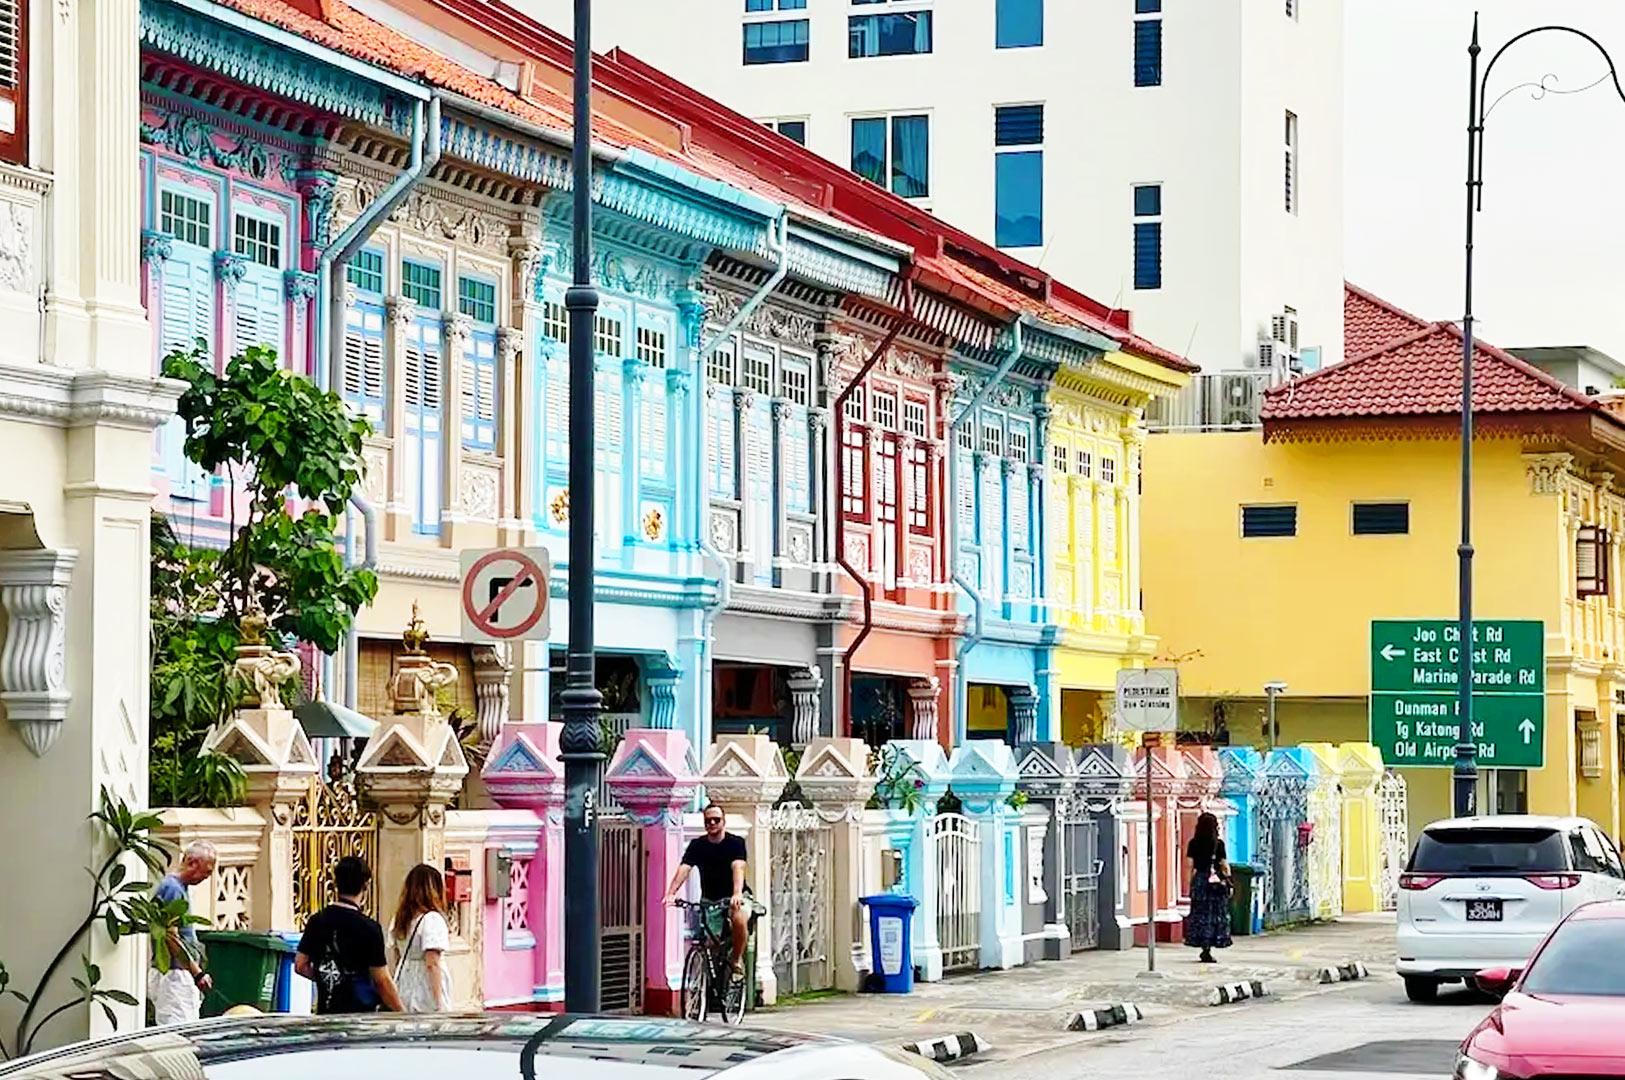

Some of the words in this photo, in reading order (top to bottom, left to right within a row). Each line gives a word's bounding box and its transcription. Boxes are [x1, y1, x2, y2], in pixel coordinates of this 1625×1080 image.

[1413, 627, 1436, 642] Joo
[1444, 627, 1479, 642] Cht
[1486, 626, 1503, 642] Rd
[1413, 647, 1442, 663] East
[1449, 647, 1487, 663] Cst
[1494, 647, 1511, 663] Rd
[1413, 668, 1459, 683] Marine
[1519, 669, 1535, 685] Rd
[1395, 700, 1448, 716] Dunman
[1396, 721, 1409, 739] Tg
[1416, 721, 1460, 740] Katong
[1395, 741, 1417, 757] Old
[1424, 742, 1458, 761] Airpo
[1478, 743, 1495, 758] Rd
